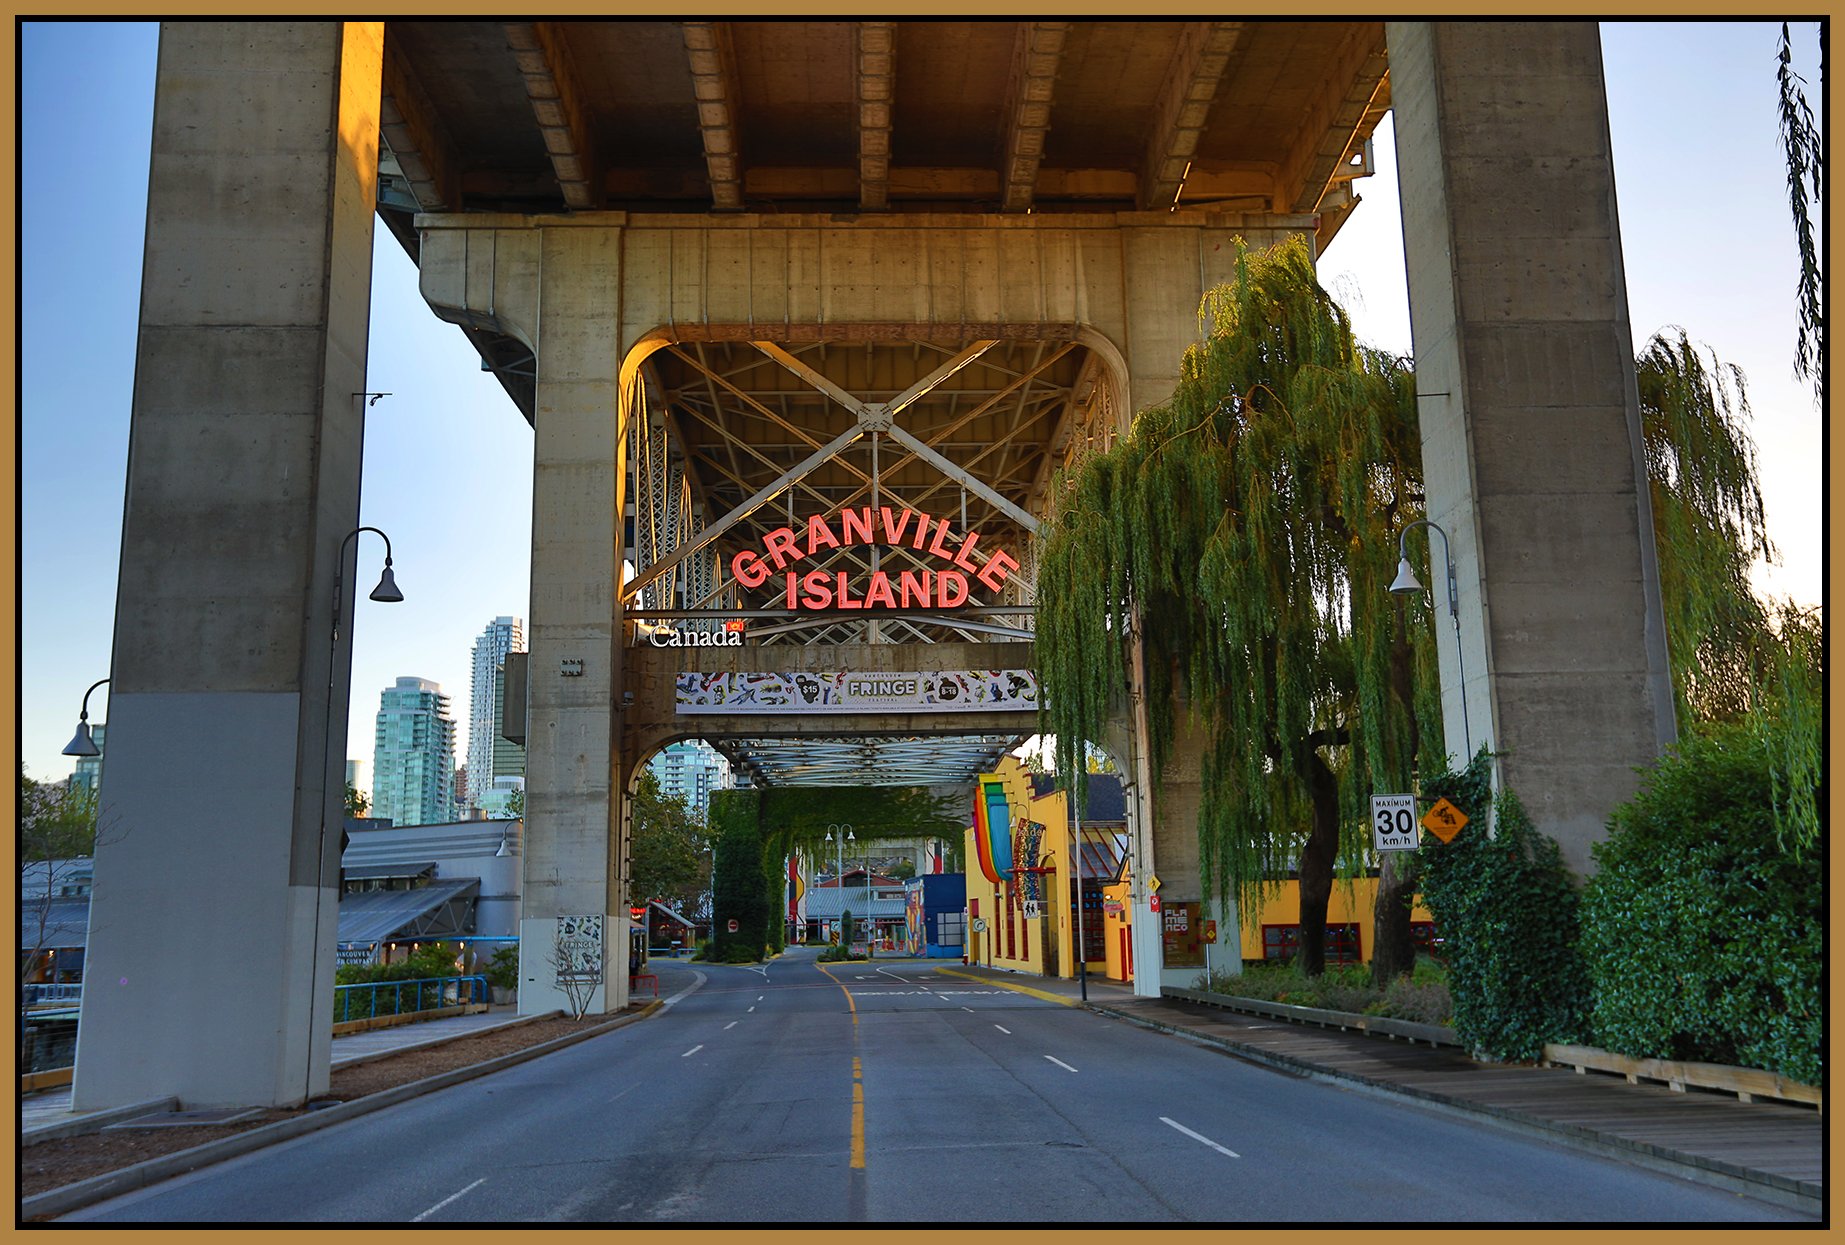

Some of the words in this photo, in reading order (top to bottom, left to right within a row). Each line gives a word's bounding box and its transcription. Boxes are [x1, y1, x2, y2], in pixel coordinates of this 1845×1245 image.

[731, 506, 1021, 594] GRANVILLE
[786, 570, 969, 610] ISLAND
[650, 624, 743, 647] Canada
[803, 685, 818, 694] $15
[850, 681, 915, 696] FRINGE
[1375, 799, 1411, 808] MAXIMUM
[1377, 809, 1413, 835] 30
[1382, 836, 1411, 846] km/h
